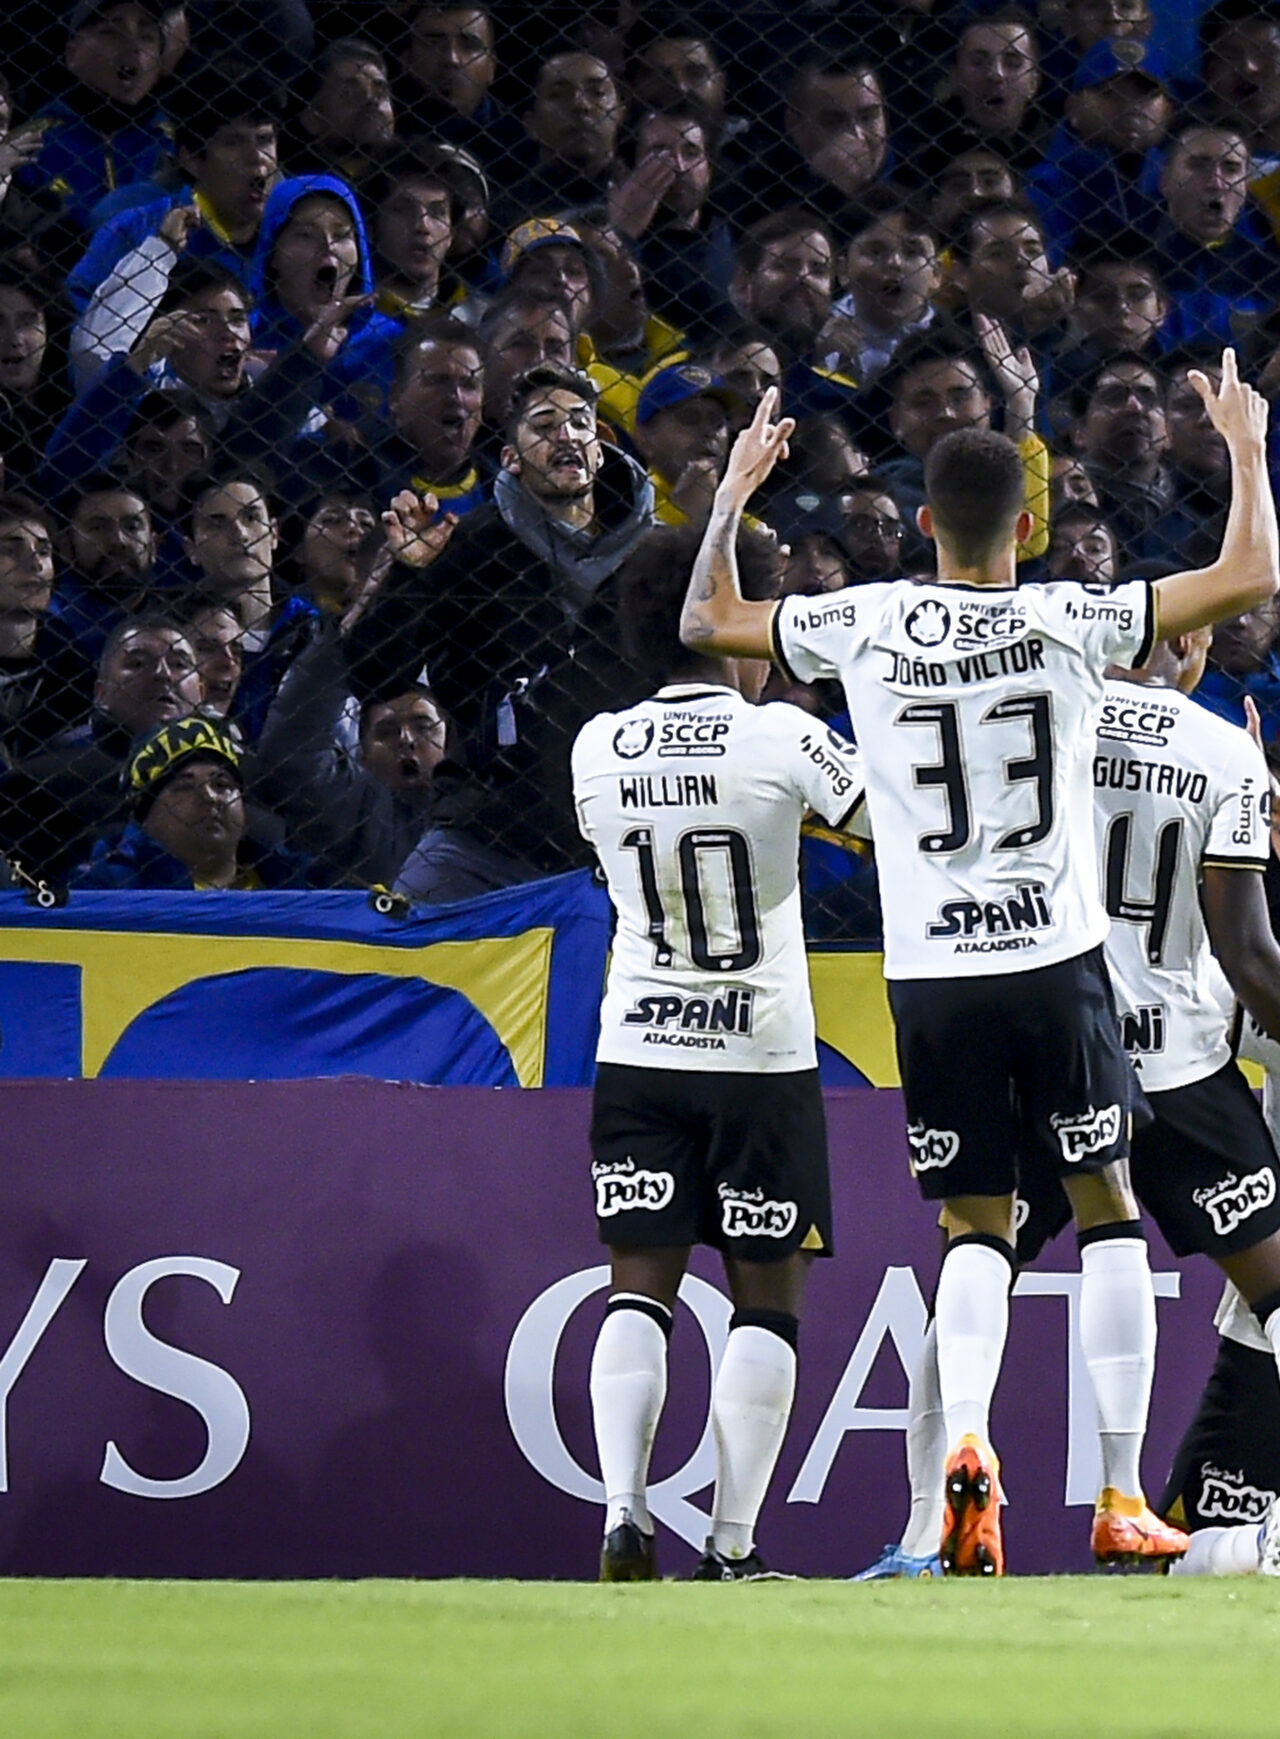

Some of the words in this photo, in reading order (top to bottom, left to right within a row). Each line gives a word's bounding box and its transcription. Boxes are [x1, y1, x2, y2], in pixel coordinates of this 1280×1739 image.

[808, 604, 856, 628] bmg
[956, 614, 1026, 638] SCCP
[1082, 604, 1134, 631] bmg
[660, 724, 730, 742] SCCP
[1100, 705, 1175, 733] SCCP
[809, 745, 853, 796] bmg
[894, 690, 1054, 857] 33
[1093, 756, 1207, 805] GUSTAVO
[1232, 795, 1252, 845] bmg
[619, 824, 764, 975] 10
[1103, 811, 1182, 968] 4
[954, 937, 1037, 954] ATACADISTA
[643, 1033, 726, 1050] ATACADISTA
[912, 1133, 956, 1166] oty
[600, 1174, 672, 1213] Poty
[1210, 1171, 1274, 1231] Poty
[724, 1203, 795, 1235] Poty
